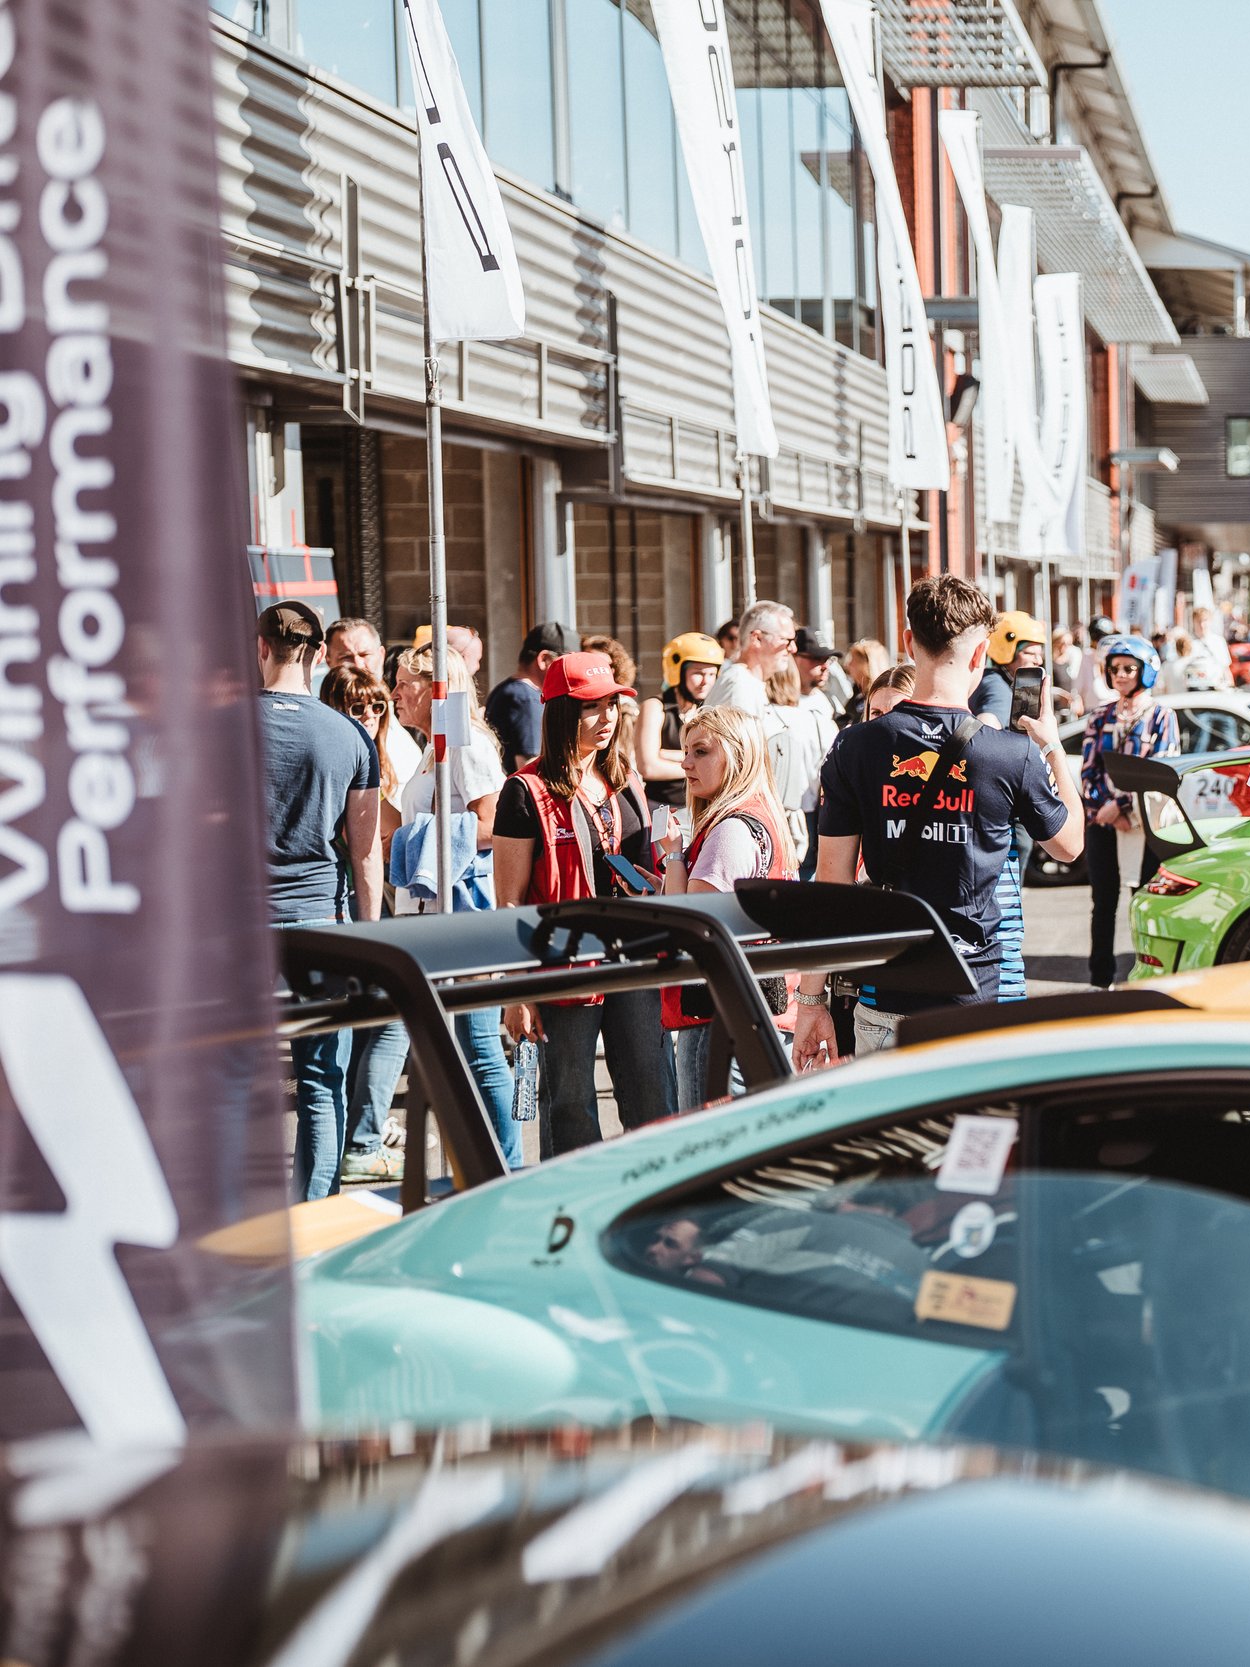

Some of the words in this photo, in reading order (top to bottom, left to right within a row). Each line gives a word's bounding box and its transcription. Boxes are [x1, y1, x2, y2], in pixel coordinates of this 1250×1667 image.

[37, 96, 141, 914] Performance
[1196, 777, 1235, 797] 240
[886, 819, 944, 841] Mbil
